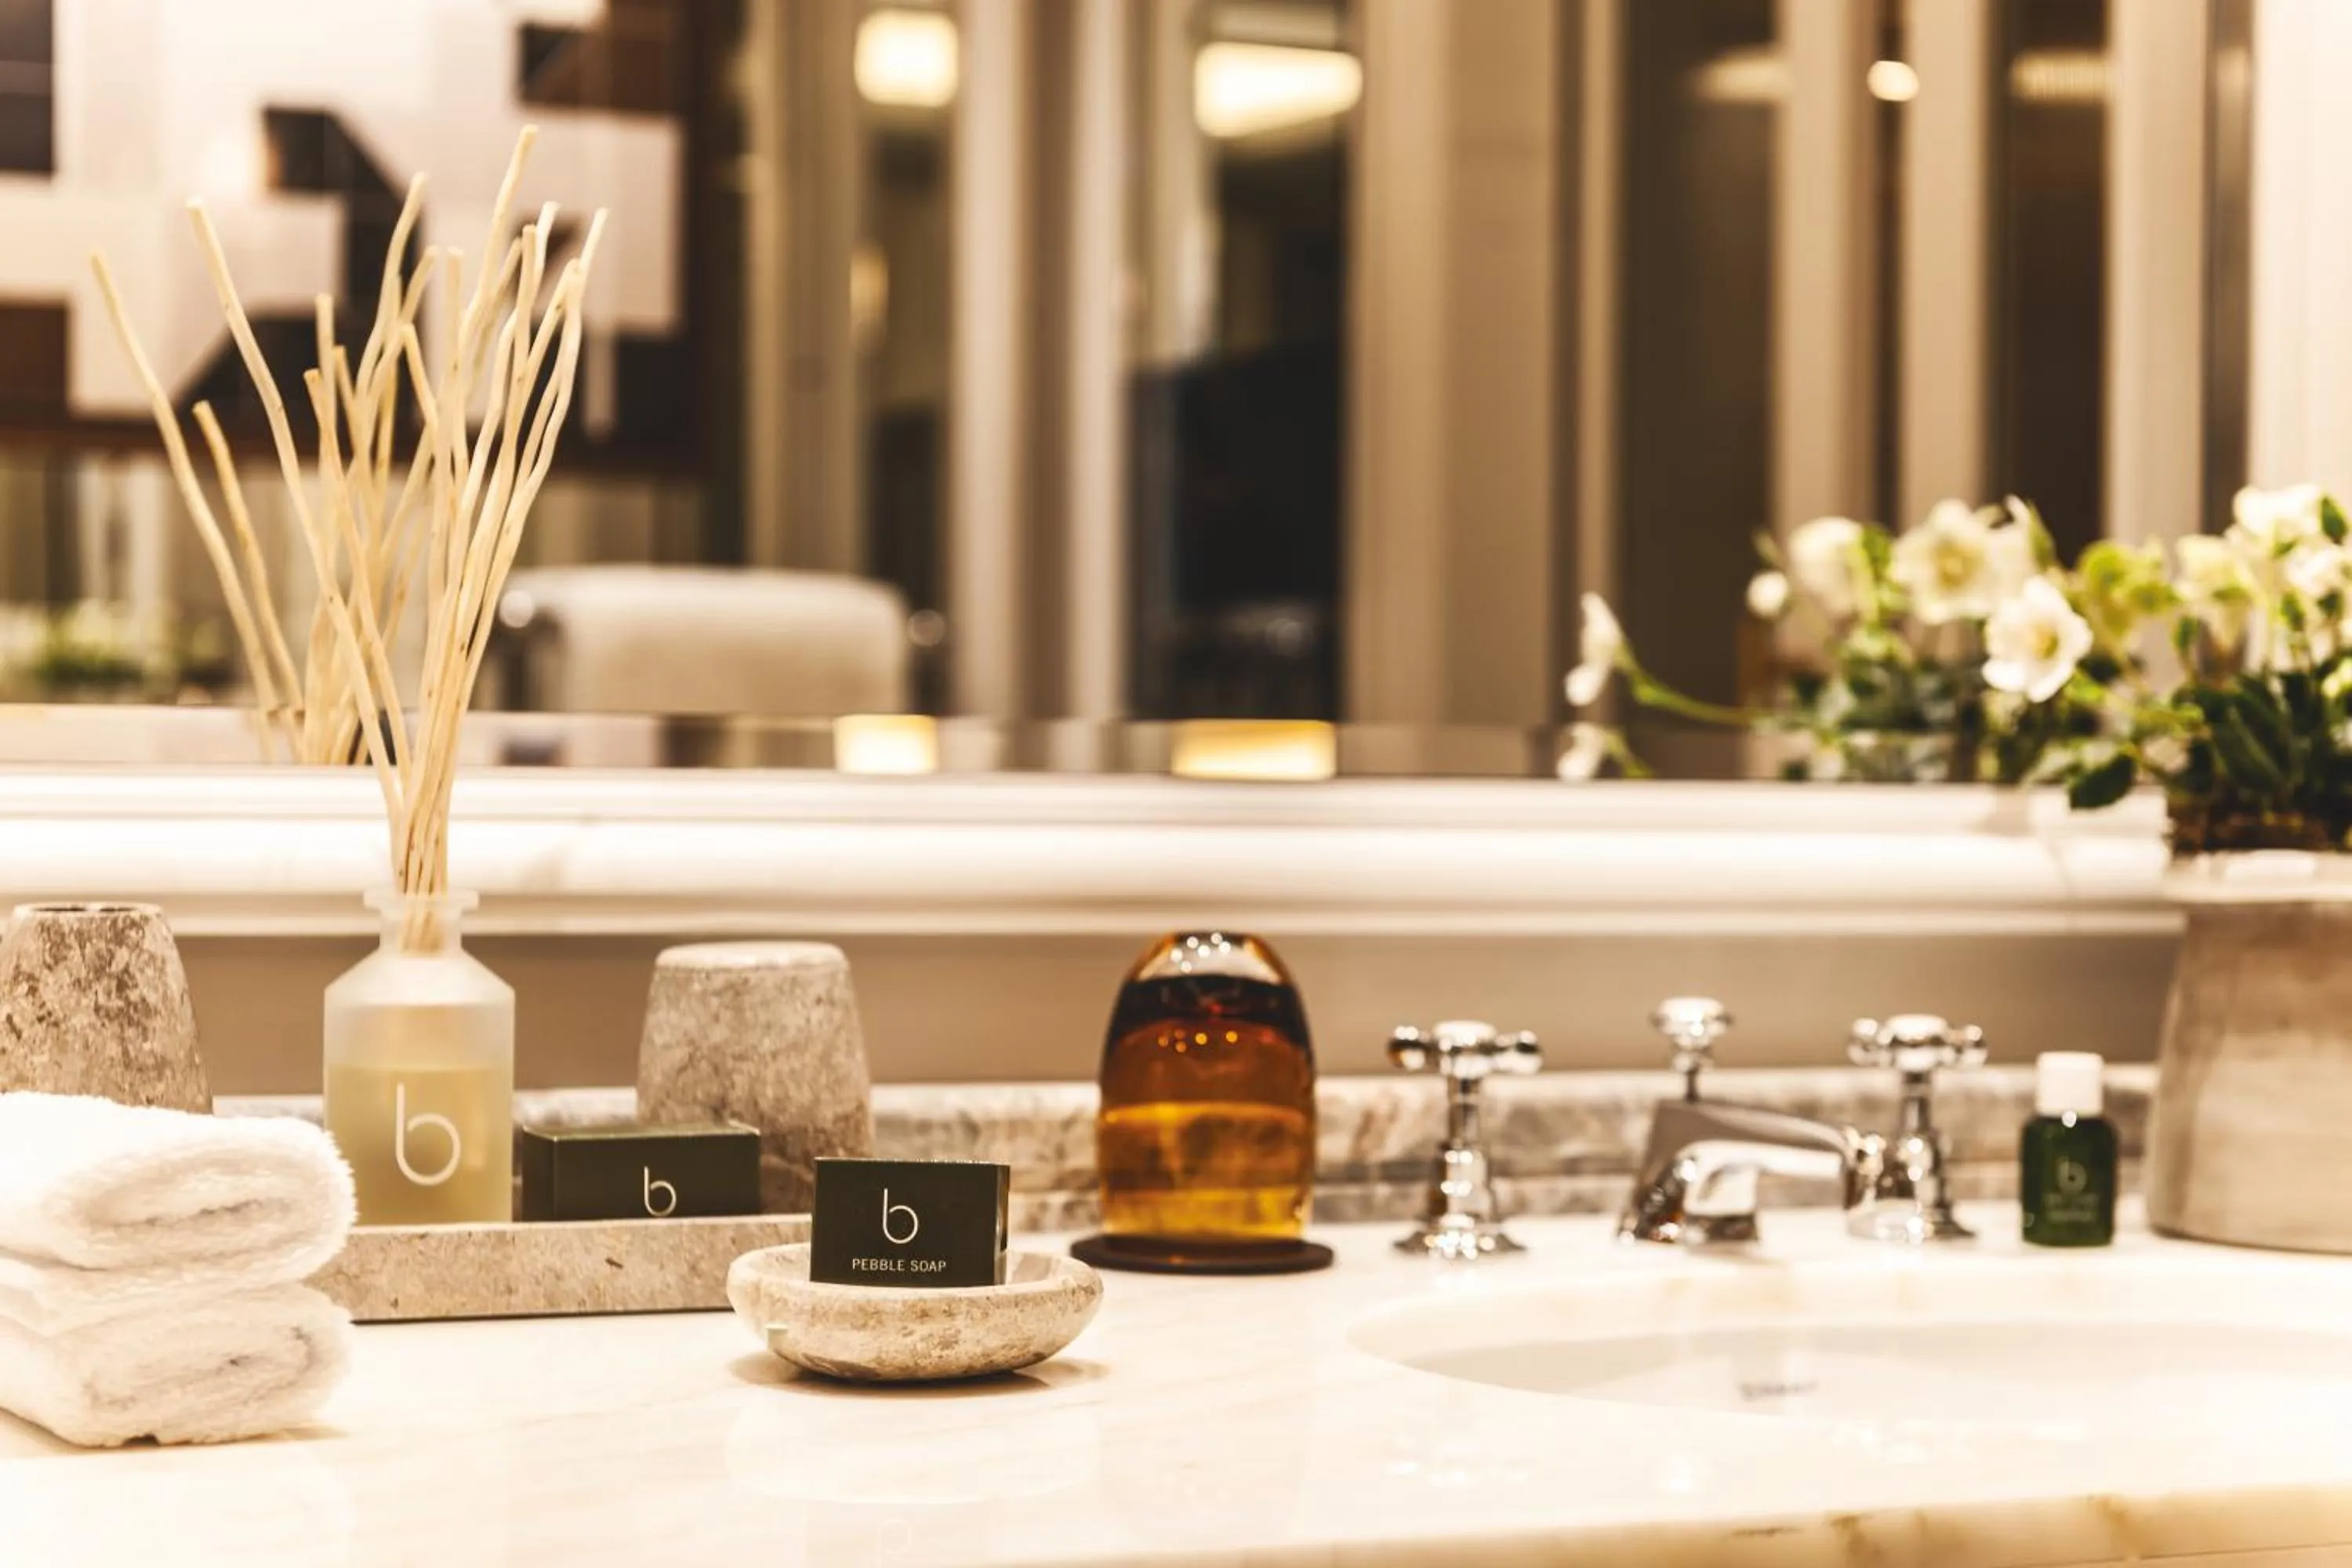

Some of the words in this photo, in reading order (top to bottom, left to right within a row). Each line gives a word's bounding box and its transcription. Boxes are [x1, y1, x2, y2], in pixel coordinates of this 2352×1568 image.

[395, 1082, 461, 1186] b
[643, 1166, 677, 1217] b
[882, 1187, 919, 1244] b
[851, 1258, 905, 1272] PEBBLE
[909, 1259, 947, 1272] SOAP
